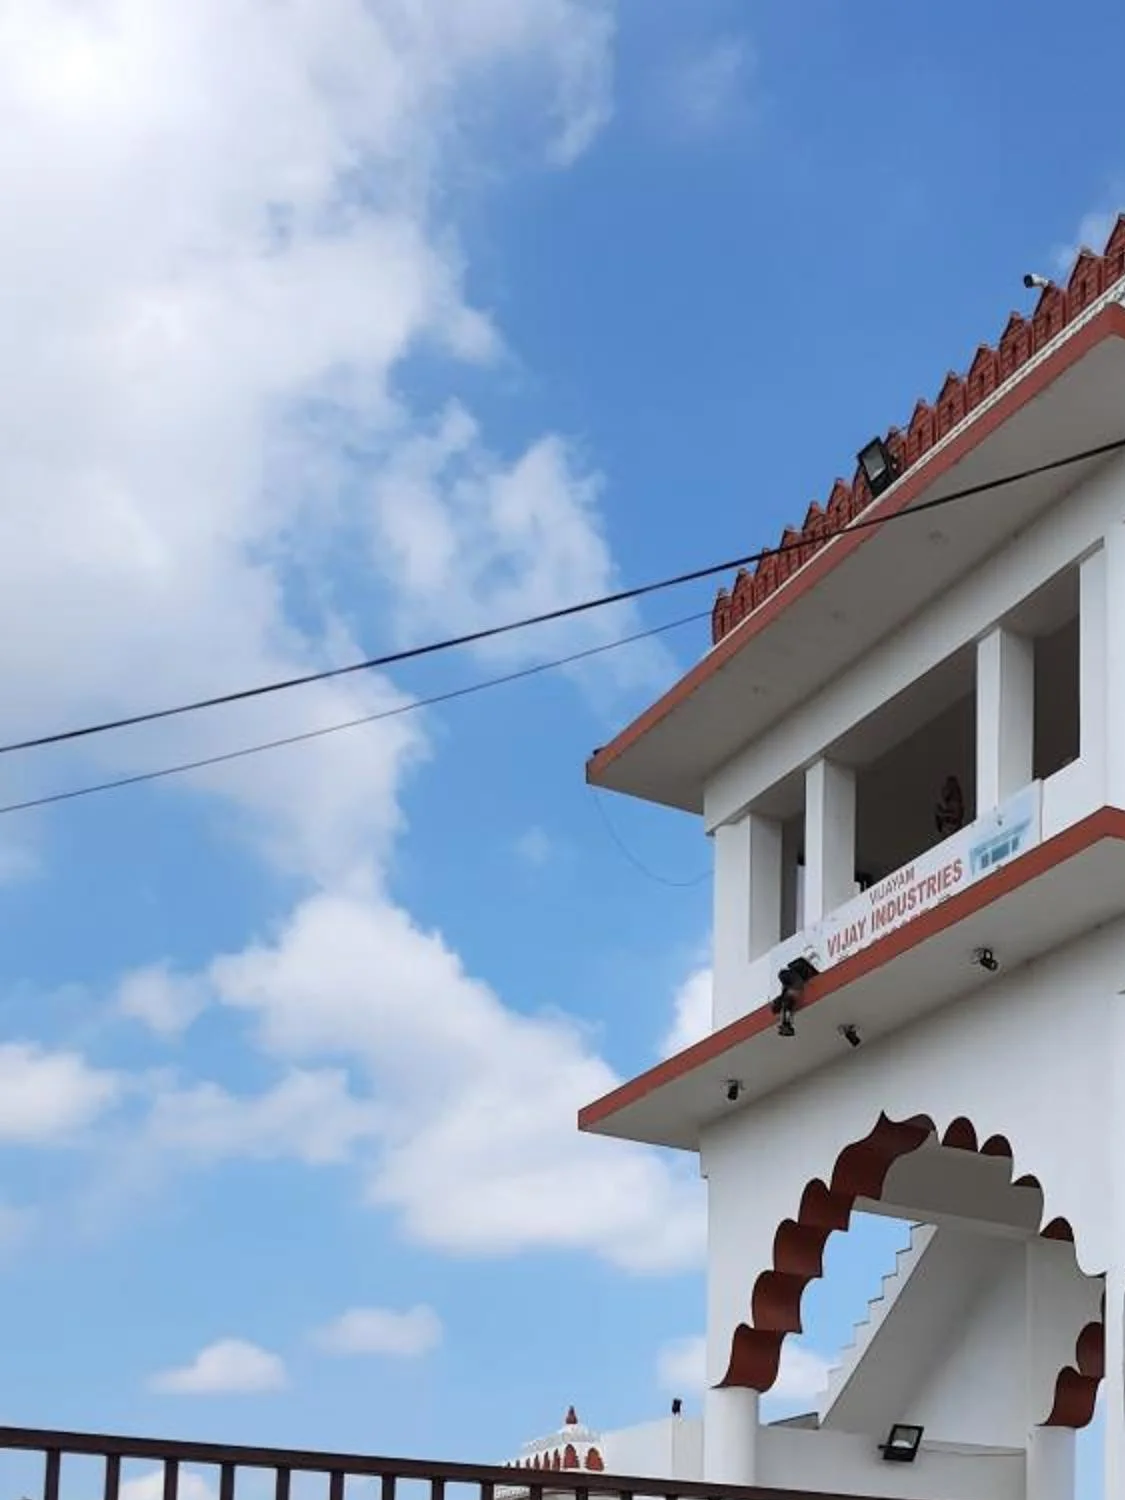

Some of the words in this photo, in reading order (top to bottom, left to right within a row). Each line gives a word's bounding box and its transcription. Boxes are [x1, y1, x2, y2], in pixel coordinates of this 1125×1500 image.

[827, 919, 867, 957] VIJAY
[871, 858, 963, 934] INDUSTRIES
[869, 864, 916, 904] VIJAYAM
